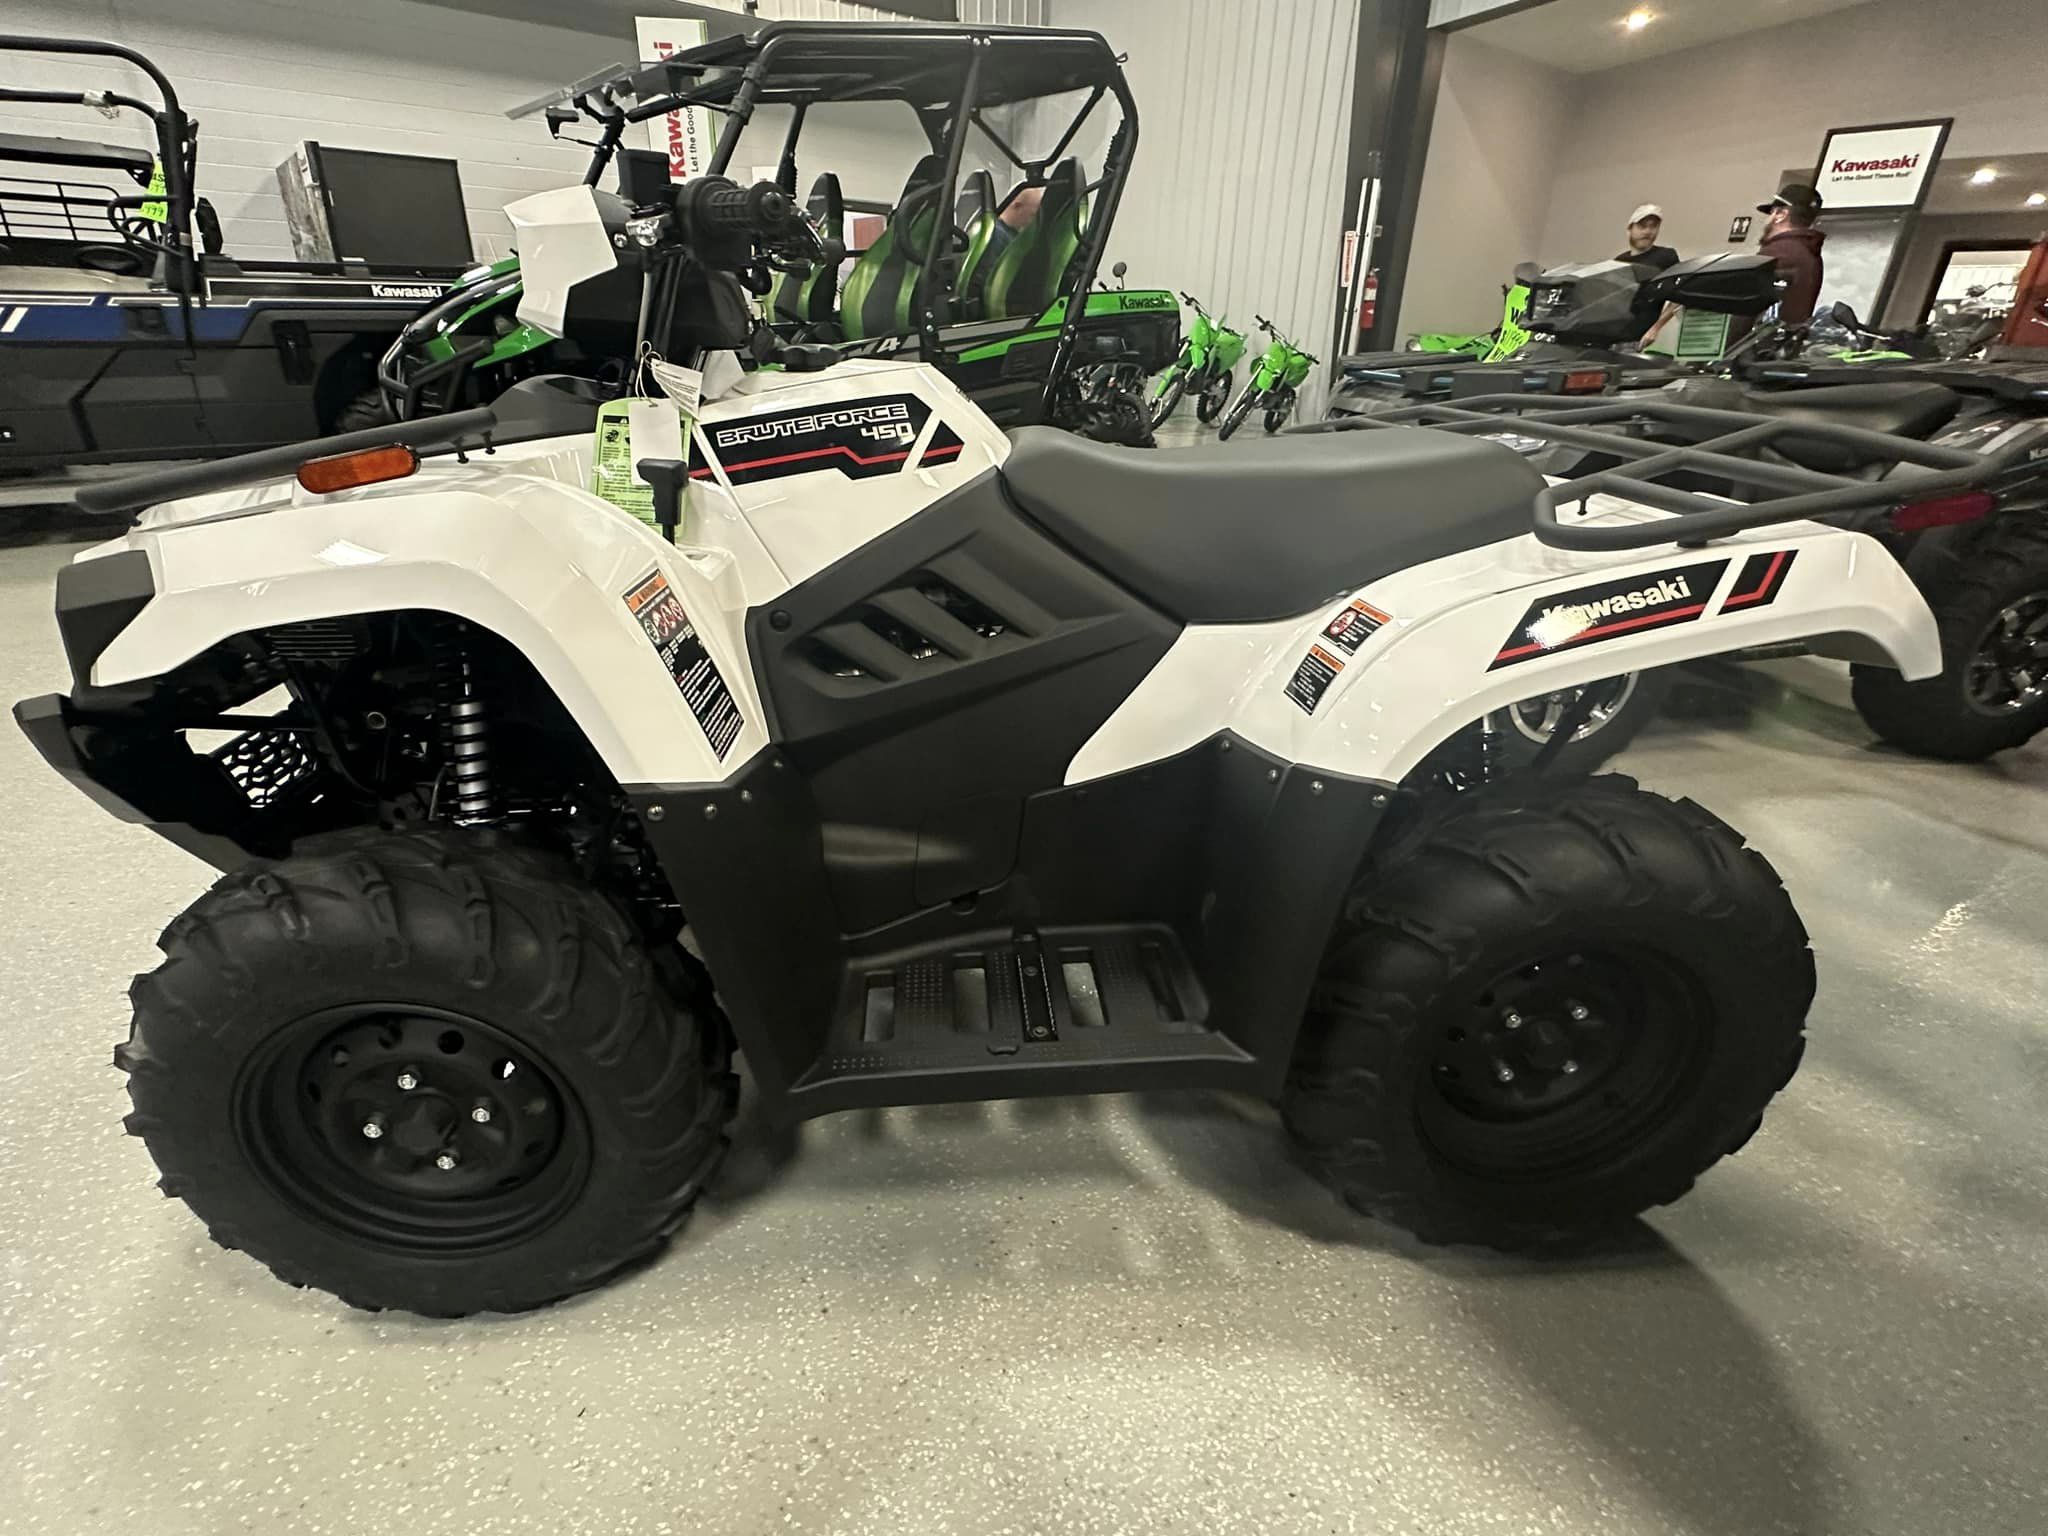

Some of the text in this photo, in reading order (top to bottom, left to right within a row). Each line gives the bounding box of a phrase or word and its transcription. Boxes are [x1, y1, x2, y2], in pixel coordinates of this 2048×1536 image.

[689, 137, 697, 153] the
[691, 156, 700, 172] Let
[1831, 154, 1920, 173] Kawasaki
[371, 285, 443, 298] Kawasaki
[1119, 294, 1171, 310] Kawasaki
[861, 422, 915, 442] 450
